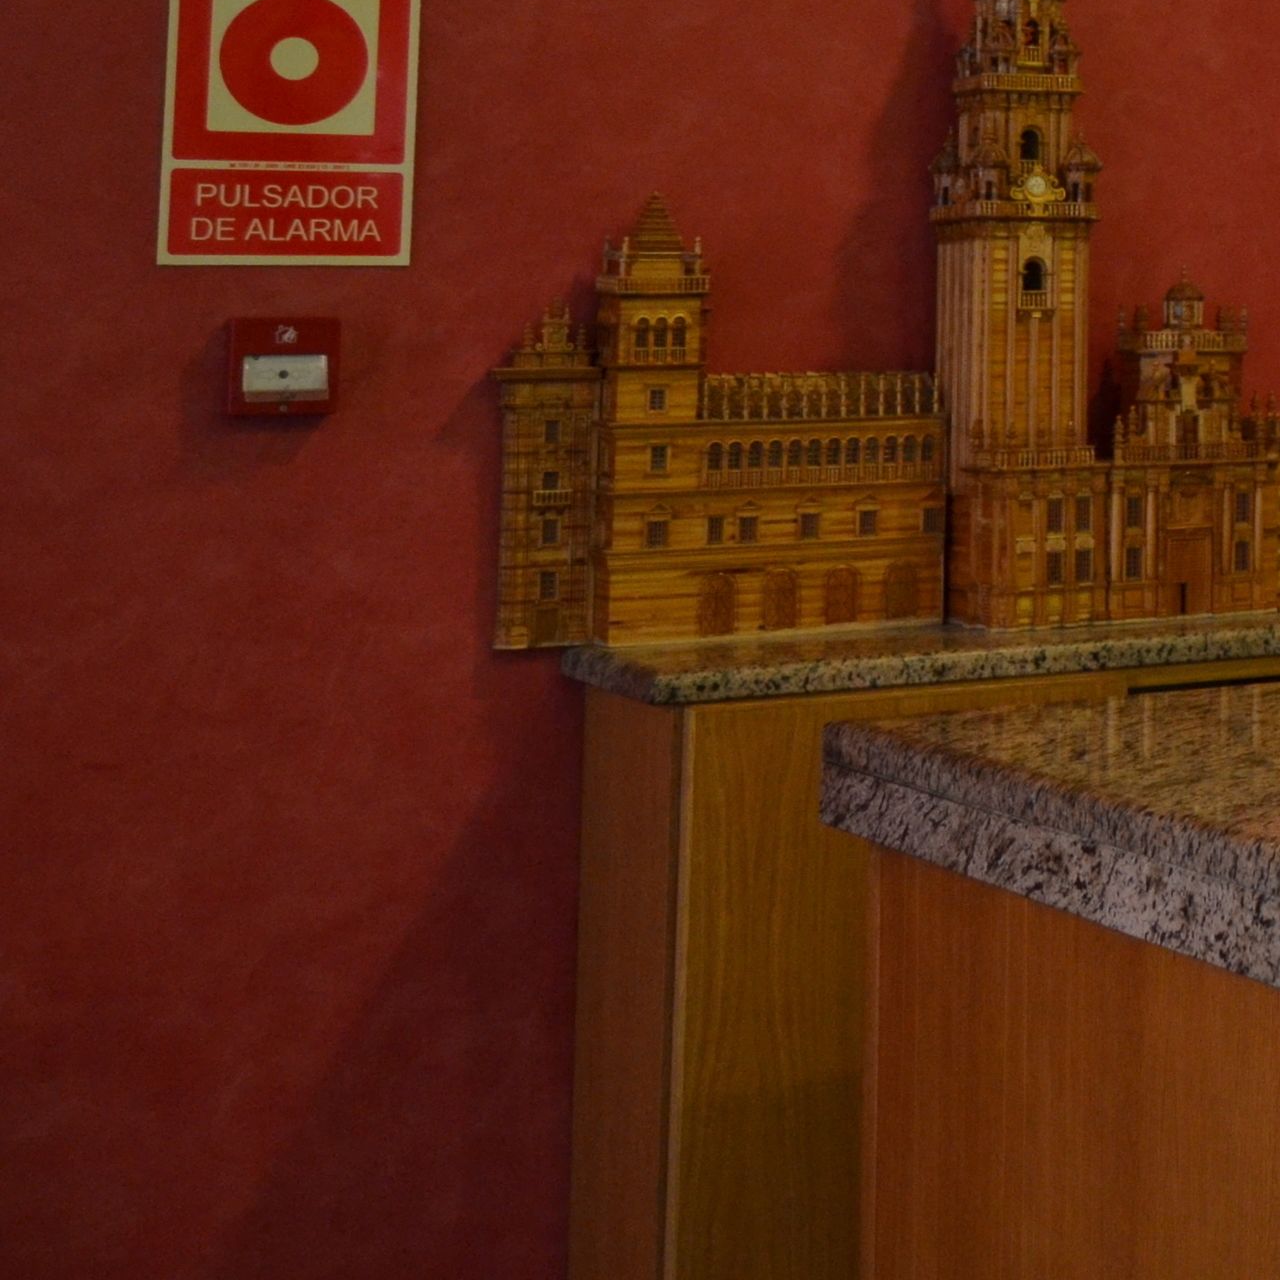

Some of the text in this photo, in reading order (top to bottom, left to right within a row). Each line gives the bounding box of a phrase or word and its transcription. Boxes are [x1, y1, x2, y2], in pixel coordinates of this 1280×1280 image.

[195, 183, 379, 209] PULSADOR
[190, 217, 381, 242] DE ALARMA
